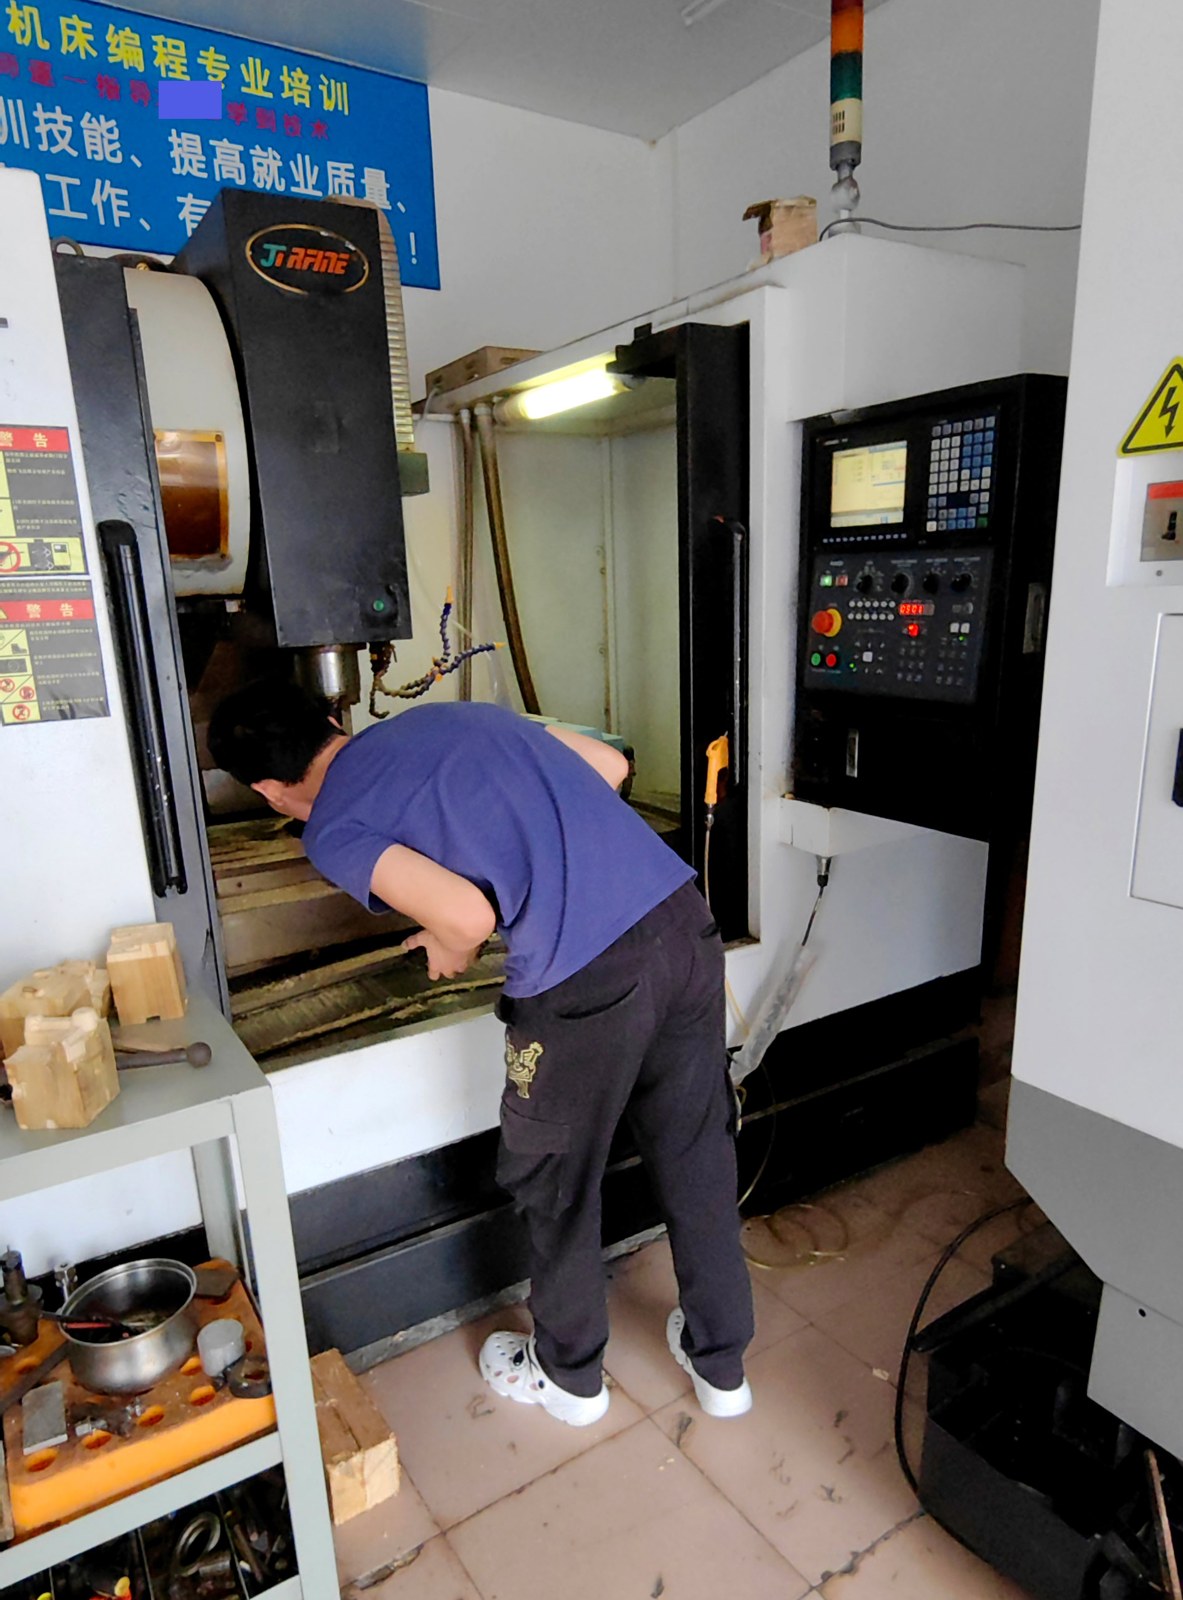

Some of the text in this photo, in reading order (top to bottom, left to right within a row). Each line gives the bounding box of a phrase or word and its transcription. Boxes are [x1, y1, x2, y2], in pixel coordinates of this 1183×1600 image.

[5, 0, 350, 117] 机床编程专业培训
